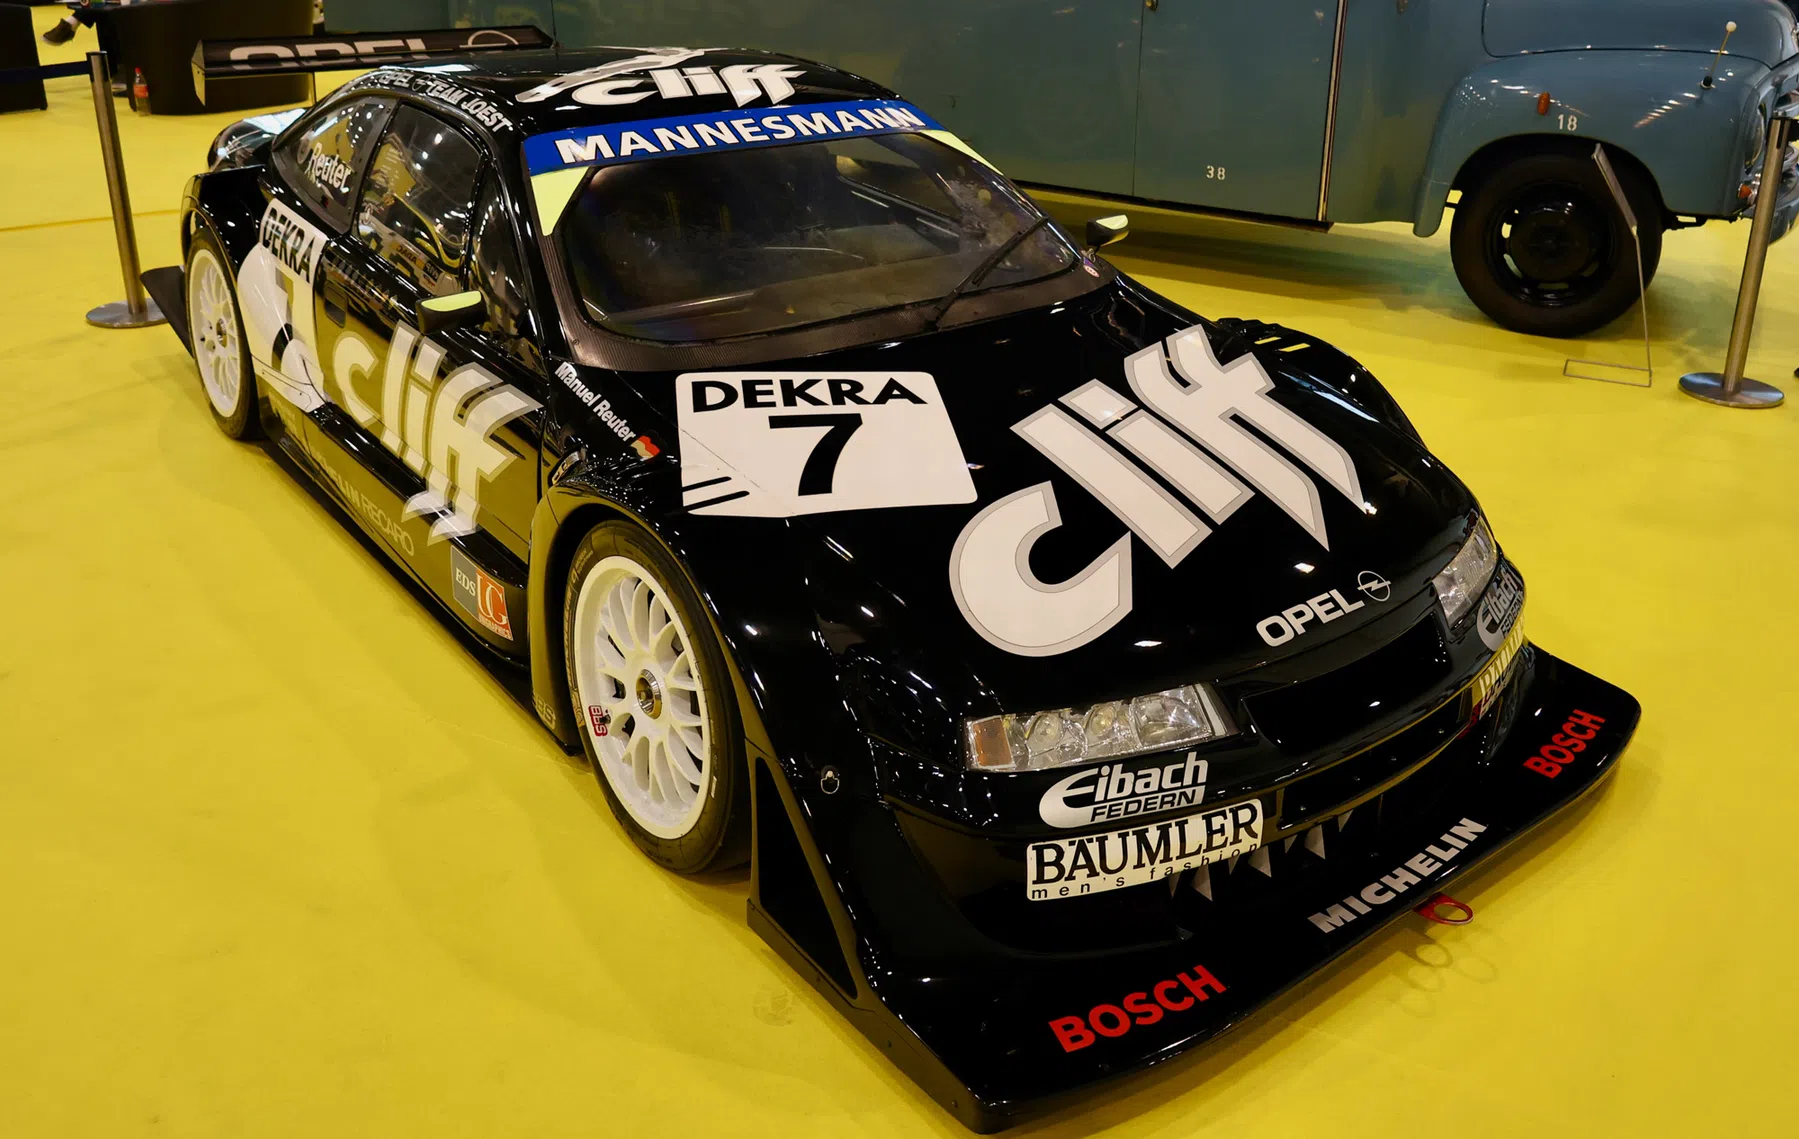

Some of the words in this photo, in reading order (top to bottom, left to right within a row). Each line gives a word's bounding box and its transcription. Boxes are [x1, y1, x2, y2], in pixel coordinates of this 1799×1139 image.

[425, 79, 468, 105] TEAM
[461, 97, 513, 132] JOEST
[571, 63, 807, 107] cliff
[554, 106, 926, 164] MANNESMANN
[1557, 114, 1577, 131] 18
[304, 142, 352, 192] Reuter
[1206, 165, 1226, 180] 38
[262, 207, 315, 285] DEKRA
[554, 361, 602, 407] Manuel
[592, 399, 636, 441] Reuter
[691, 376, 928, 412] DEKRA
[332, 322, 545, 547] cliff
[768, 413, 864, 497] 7
[949, 323, 1364, 657] cliff
[360, 492, 414, 556] RECARO
[455, 567, 476, 597] EDS
[1256, 588, 1366, 647] OPEL
[1524, 709, 1605, 779] BOSCH
[1039, 751, 1209, 829] Eibach
[1090, 788, 1197, 823] FEDERN
[1032, 802, 1259, 885] BÄUMLER
[1307, 817, 1487, 933] MICHELIN
[1048, 965, 1227, 1053] BOSCH
